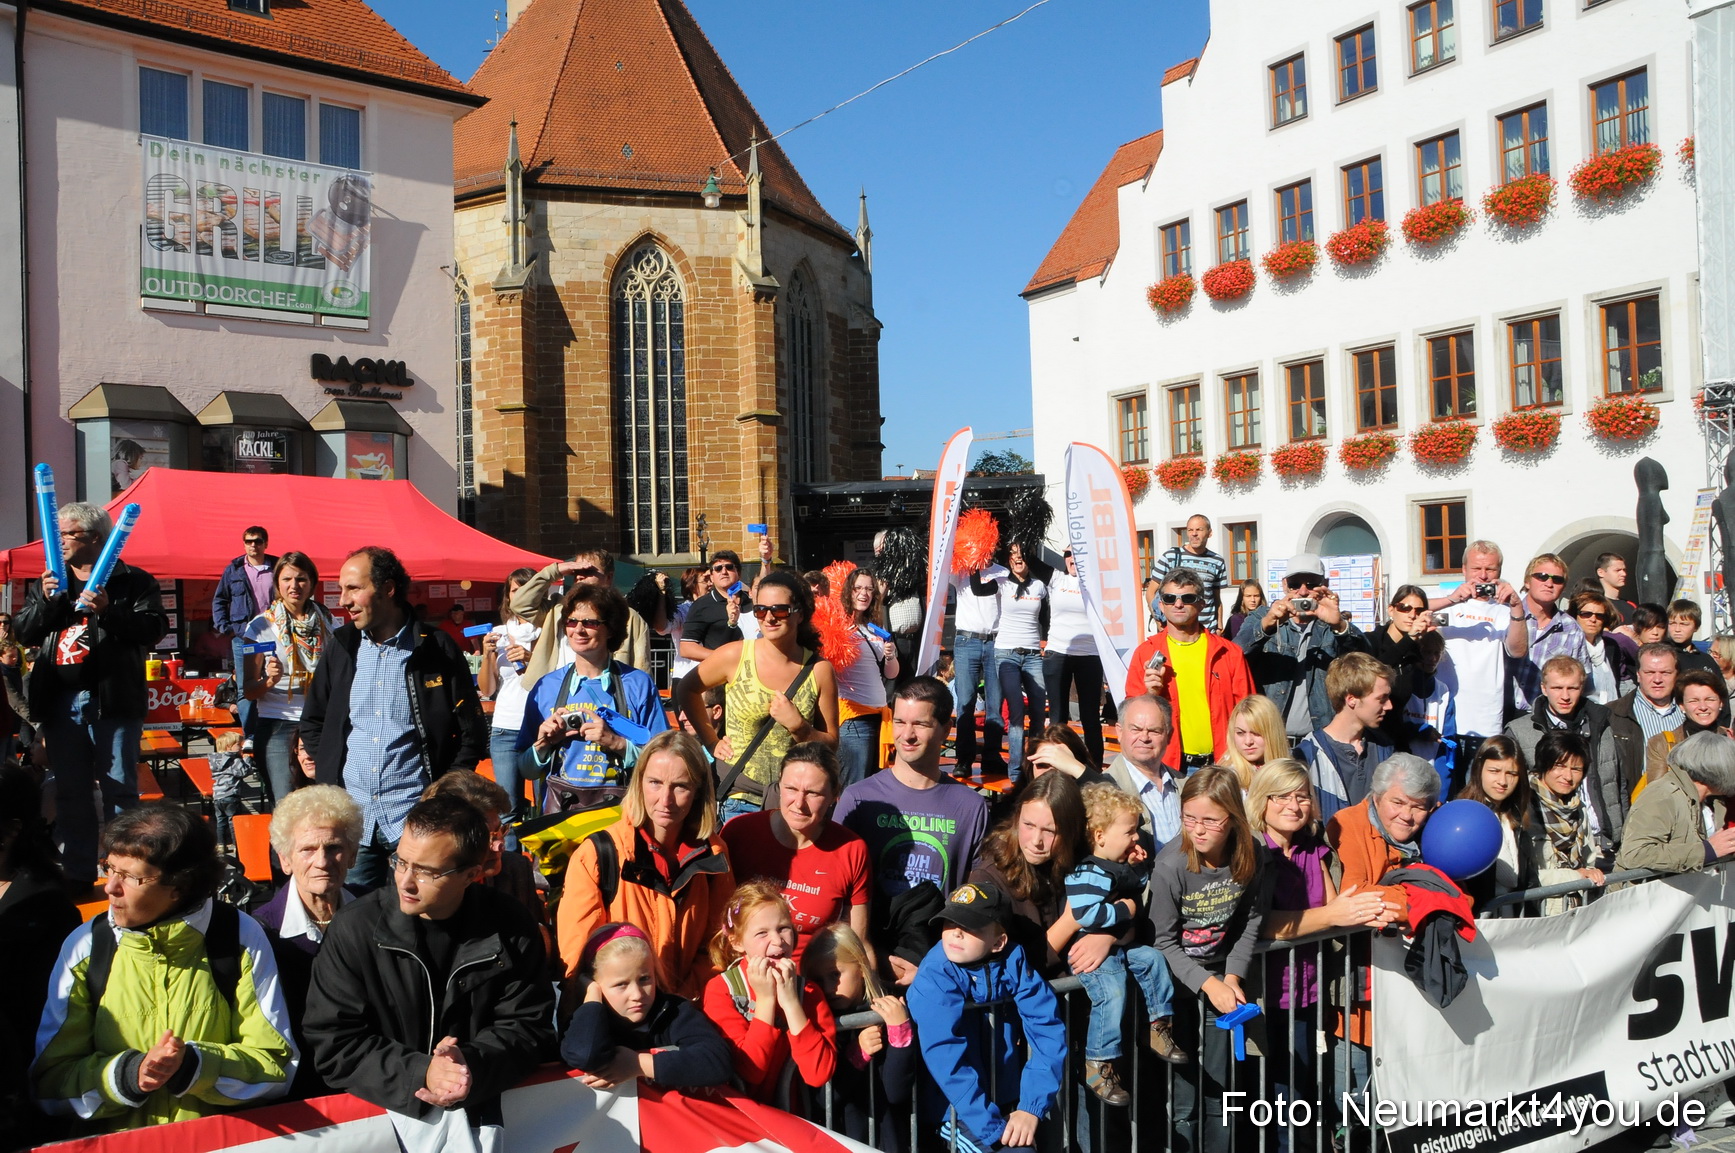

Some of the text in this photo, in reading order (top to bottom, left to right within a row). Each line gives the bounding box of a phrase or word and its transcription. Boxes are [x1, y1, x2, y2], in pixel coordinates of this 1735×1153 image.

[150, 141, 321, 184] Dein nächster
[146, 173, 326, 270] GRILL
[145, 277, 313, 310] OUTDOORCHEF.com
[311, 353, 415, 387] RACKL
[323, 382, 403, 400] am Rathaus
[238, 440, 273, 457] RACKL
[876, 814, 956, 835] GASOLINE
